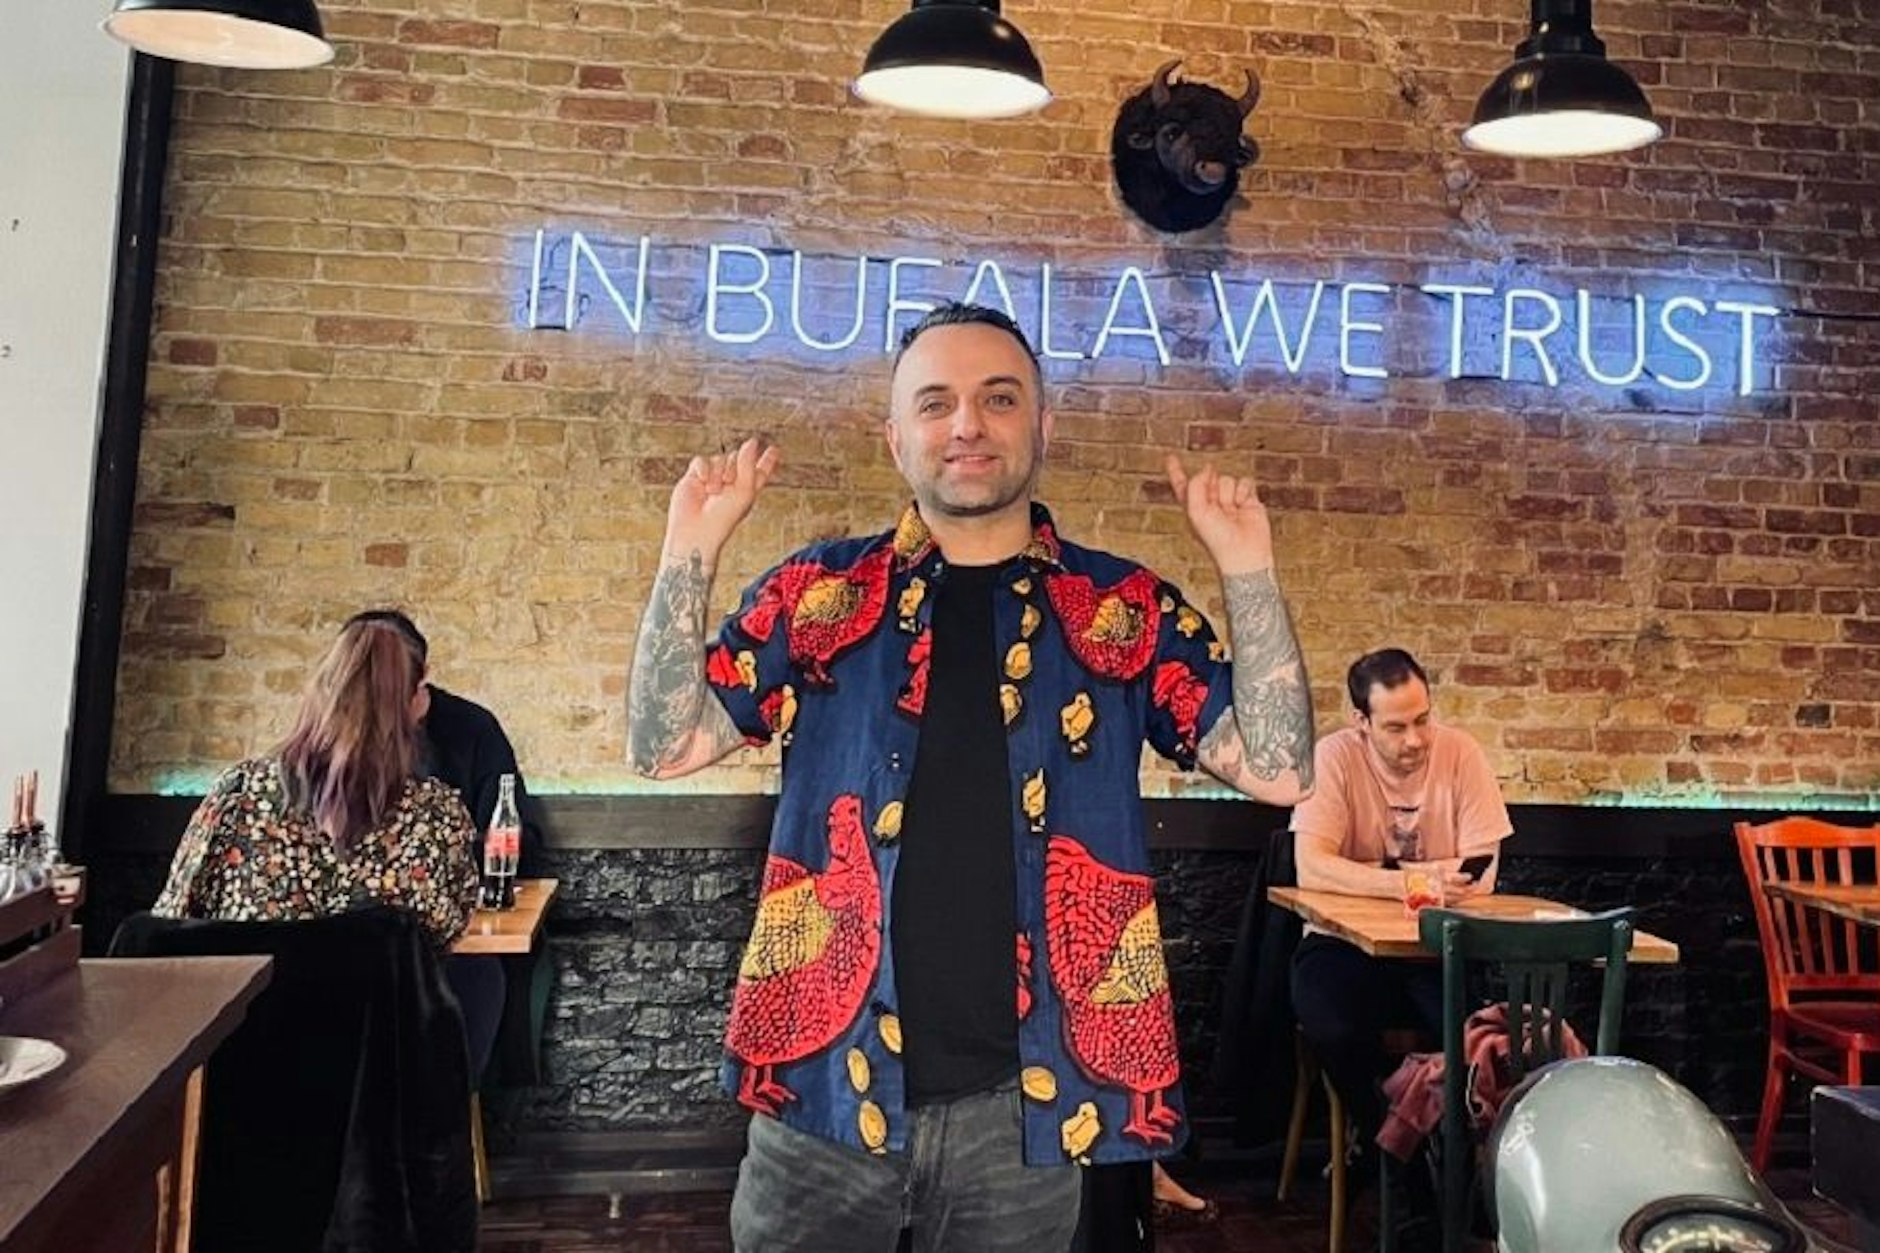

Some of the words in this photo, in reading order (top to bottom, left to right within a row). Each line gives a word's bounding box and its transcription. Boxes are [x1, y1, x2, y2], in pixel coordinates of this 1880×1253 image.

[526, 228, 649, 334] IN
[706, 244, 1171, 366] BUFALA
[1210, 270, 1390, 377] WE
[1419, 284, 1781, 396] TRUST
